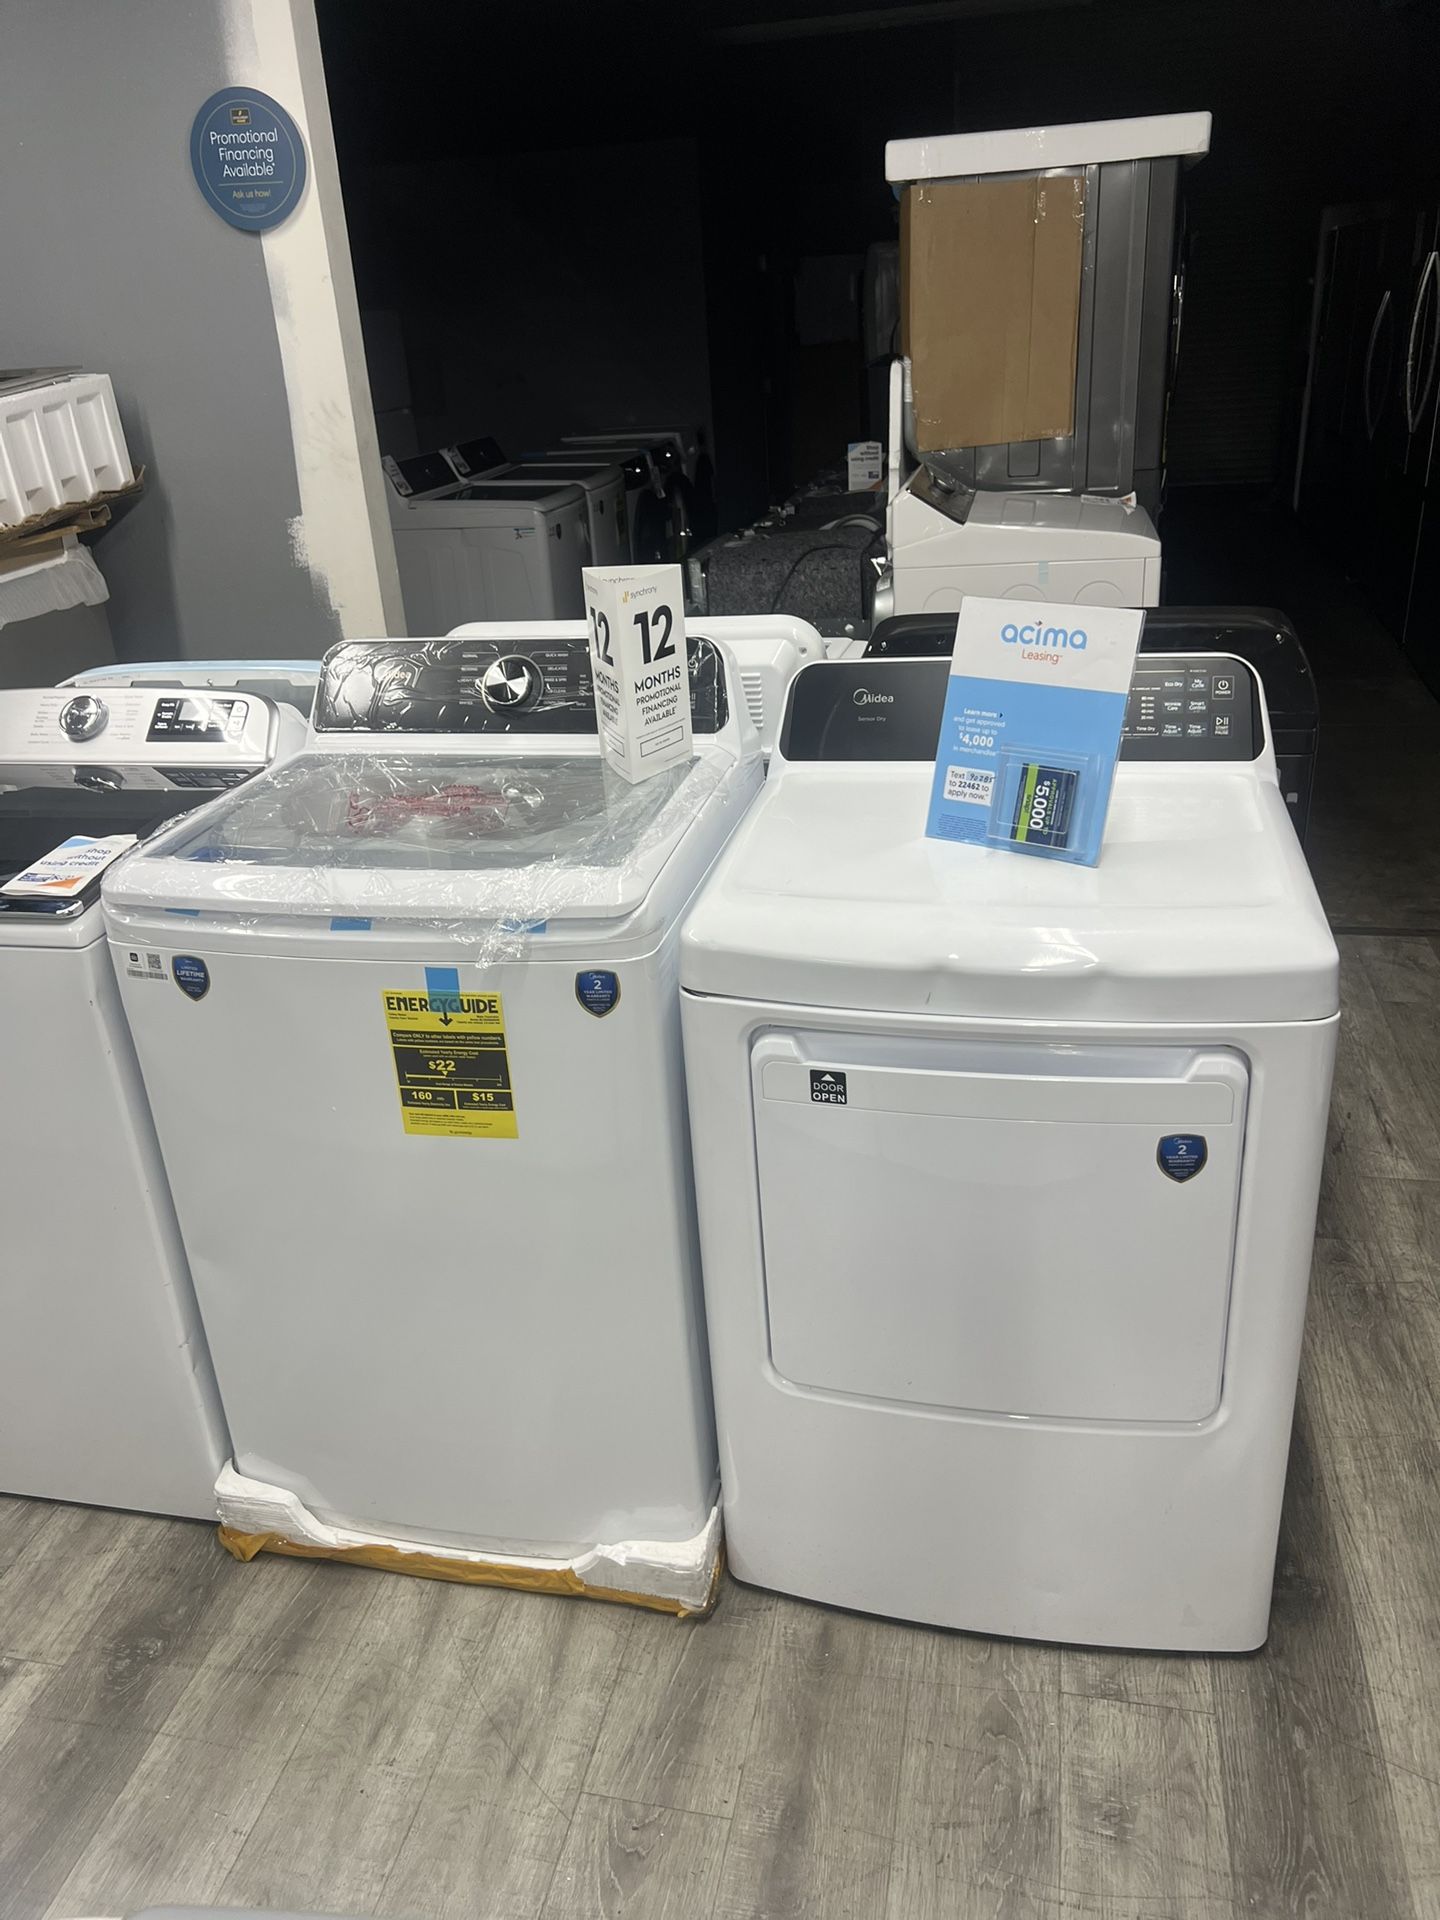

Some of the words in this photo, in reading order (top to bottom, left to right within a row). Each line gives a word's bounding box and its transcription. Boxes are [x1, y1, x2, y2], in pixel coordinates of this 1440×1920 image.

[210, 128, 278, 144] Promotional
[218, 146, 274, 162] Financing
[232, 190, 244, 199] Ask
[630, 586, 658, 599] synchrony
[633, 604, 676, 665] 12
[1001, 621, 1088, 650] acima
[634, 666, 681, 694] MONTHS
[636, 682, 682, 706] PROMOTIONAL
[853, 688, 894, 705] Midea
[642, 695, 678, 716] FINANCING
[960, 732, 994, 748] $4,000
[950, 770, 965, 779] Text
[958, 780, 980, 790] 22462
[948, 789, 968, 798] apply
[176, 970, 205, 978] LIFETIME
[594, 980, 602, 990] 2
[386, 996, 498, 1014] ENERGYGUIDE
[428, 1060, 456, 1071] $22
[813, 1082, 844, 1092] DOOR
[412, 1091, 432, 1100] 160
[472, 1092, 494, 1102] $15
[812, 1092, 845, 1103] OPEN
[1178, 1144, 1187, 1154] 2
